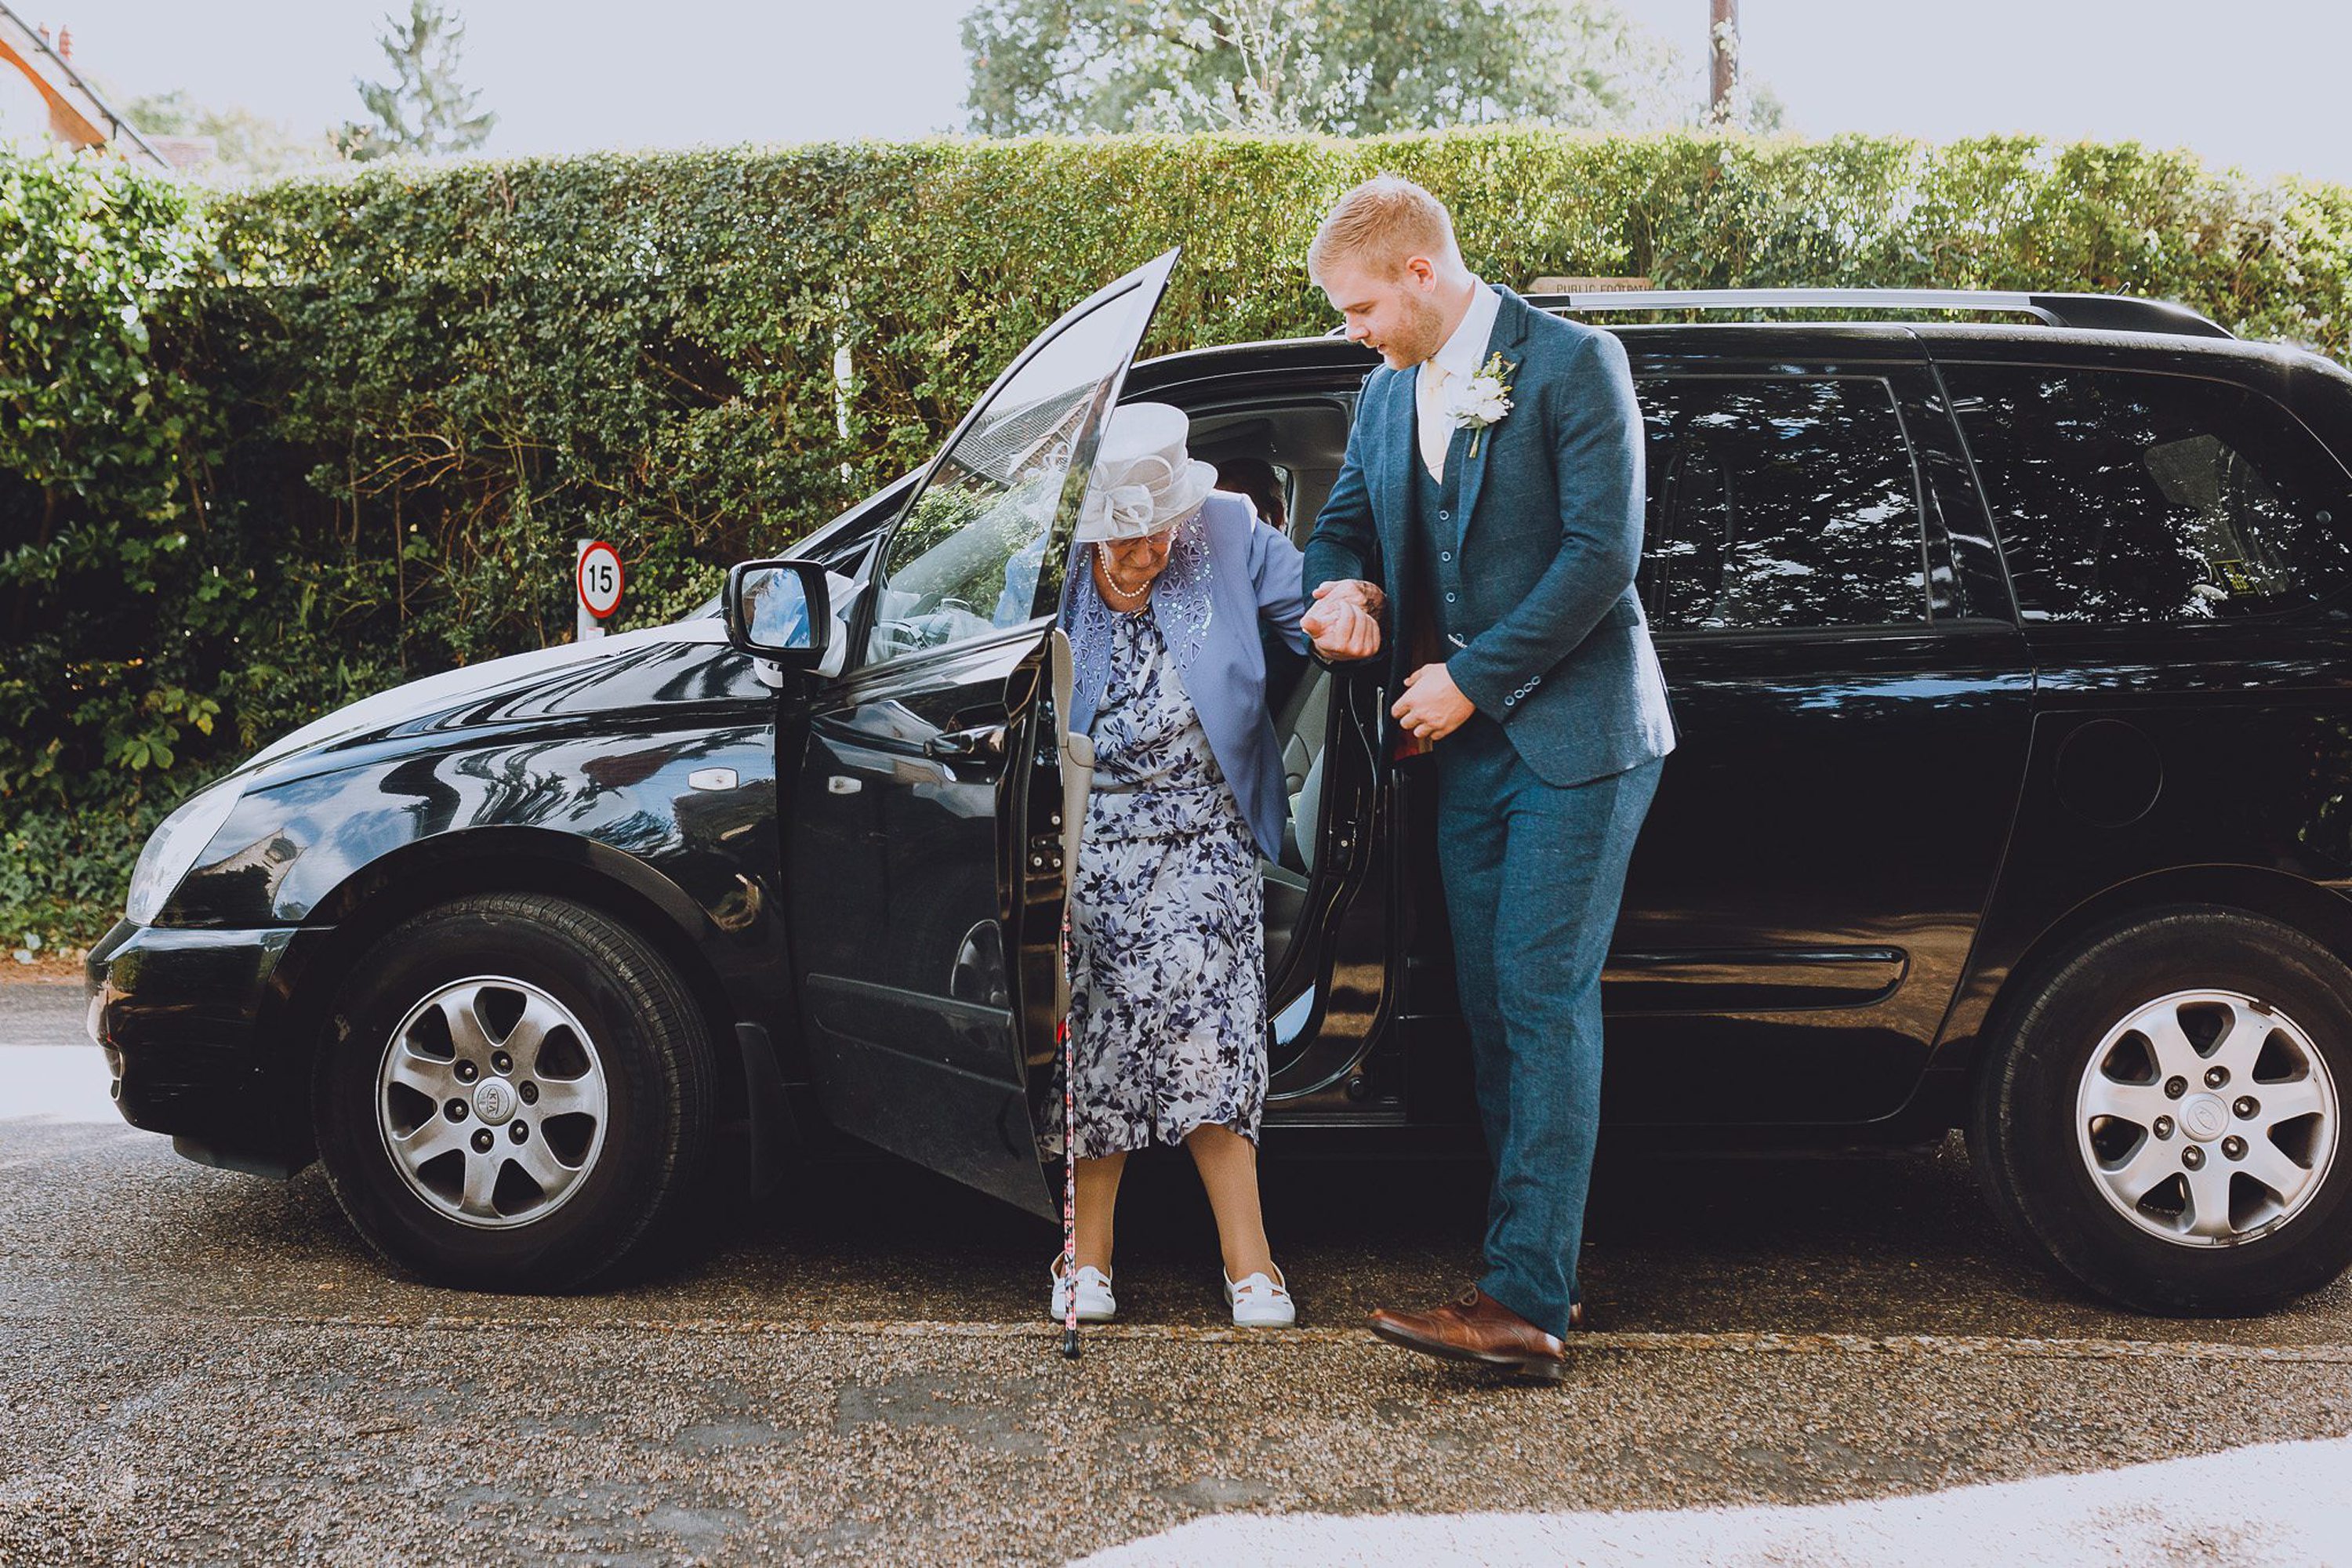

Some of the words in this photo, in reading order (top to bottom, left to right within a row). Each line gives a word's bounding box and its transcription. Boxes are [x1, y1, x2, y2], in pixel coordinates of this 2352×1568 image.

[1556, 284, 1596, 293] PUBLIC
[589, 564, 613, 593] 15
[488, 1093, 497, 1112] KIA
